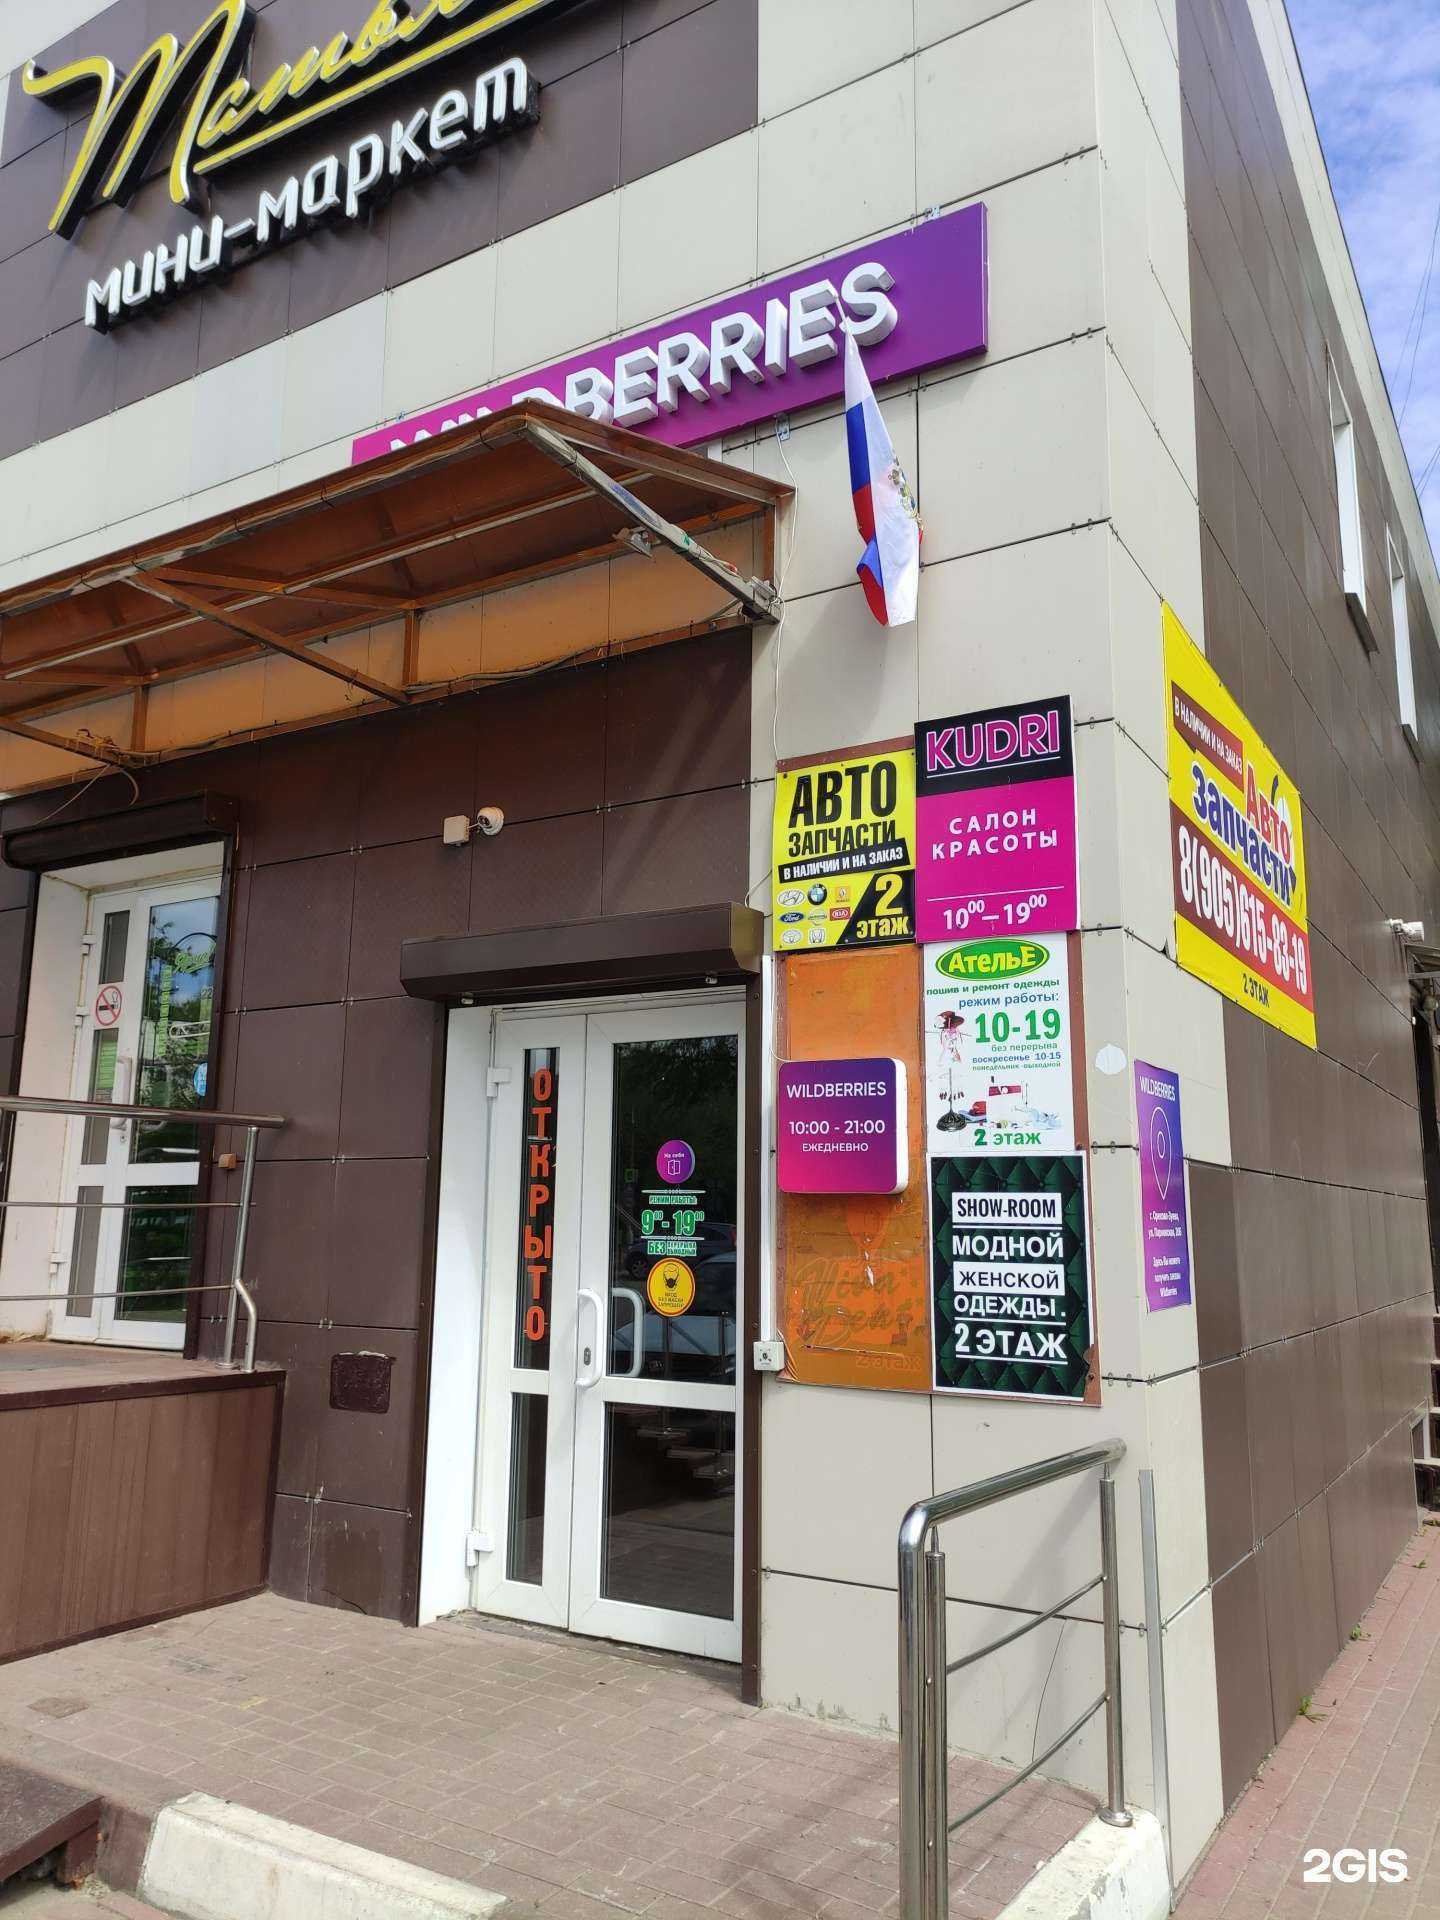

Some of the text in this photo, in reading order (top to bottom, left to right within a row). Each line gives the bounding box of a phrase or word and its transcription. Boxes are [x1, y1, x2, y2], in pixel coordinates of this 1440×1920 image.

[84, 57, 533, 328] мини-маркет
[388, 261, 900, 451] BERRIES
[926, 710, 1060, 772] KUDRI
[1180, 701, 1211, 747] НАЛИЧИИ
[1216, 736, 1225, 760] НА
[1225, 745, 1243, 775] ЗАКАЗ
[788, 760, 897, 828] АВТО
[949, 808, 1037, 835] САЛОН
[1192, 764, 1290, 907] Запчасти
[788, 820, 896, 857] ЗАПЧАСТИ
[932, 829, 1058, 860] КРАСОТЫ
[783, 846, 903, 880] В НАЛИЧИИ И НА ЗАКАЗ
[874, 873, 903, 916] 2
[1178, 825, 1307, 995] 8(905)615-83-19
[856, 915, 910, 939] этаж
[926, 979, 1060, 996] пошив и ремонт одежды
[958, 992, 1059, 1010] режим работы:
[1243, 973, 1270, 1007] 2 ЭТАЖ
[975, 1008, 1061, 1044] 10-19
[972, 1051, 1061, 1064] воскресенье 10-15
[991, 1043, 1058, 1053] без перерыва
[786, 1081, 887, 1098] WILDBERRIES
[1139, 1075, 1176, 1101] WILDBERRIES
[789, 1121, 829, 1135] 10:00
[844, 1120, 885, 1134] 21:00
[974, 1128, 1042, 1146] 2 этаж
[802, 1142, 869, 1153] ЕЖЕДНЕВНО
[524, 1068, 552, 1341] ОТКРЫТО
[957, 1199, 1056, 1218] SHOW-ROOM
[952, 1232, 1064, 1260] МОДНОЙ
[958, 1270, 1059, 1289] ЖЕНСКОЙ
[955, 1323, 1068, 1359] 2 ЭТАЖ
